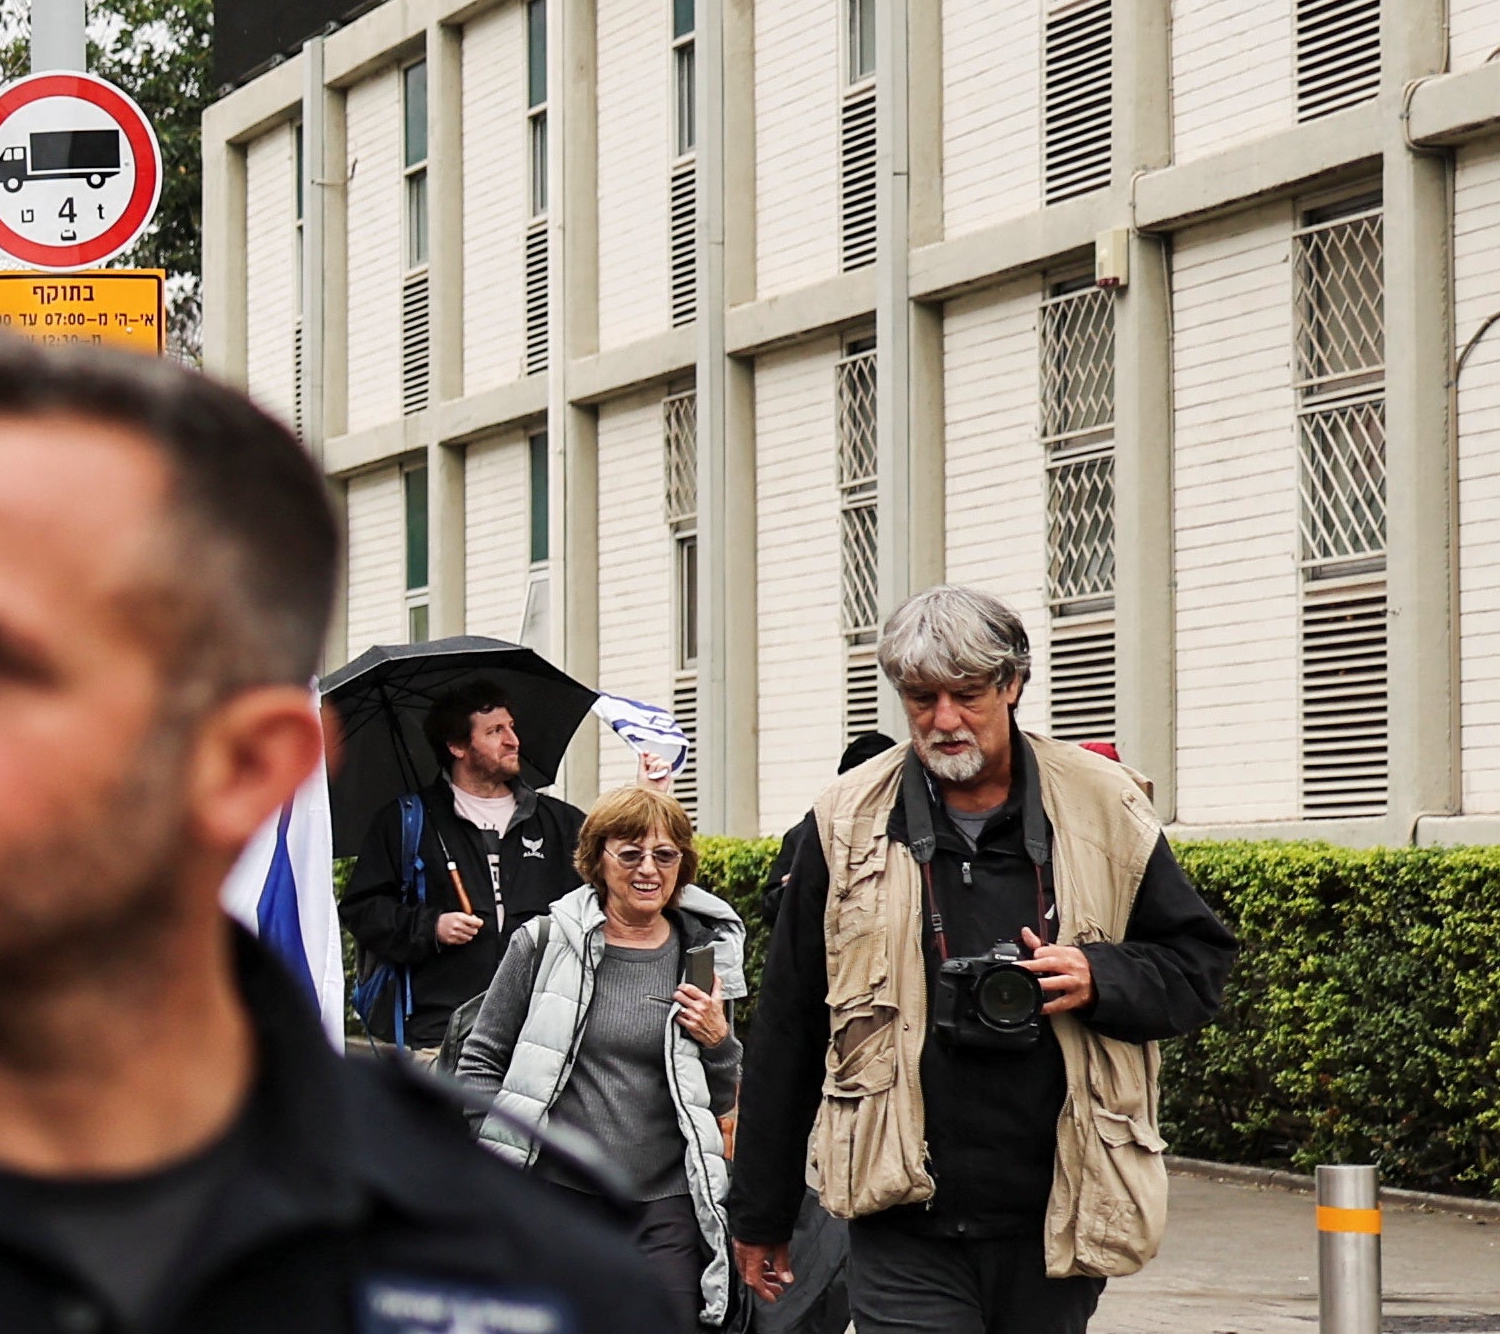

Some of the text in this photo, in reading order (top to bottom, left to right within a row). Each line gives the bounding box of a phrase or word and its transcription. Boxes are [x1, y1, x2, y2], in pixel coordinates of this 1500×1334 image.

[57, 197, 77, 223] 4
[96, 203, 105, 220] t
[32, 285, 95, 305] בתוקף
[18, 313, 38, 327] עד
